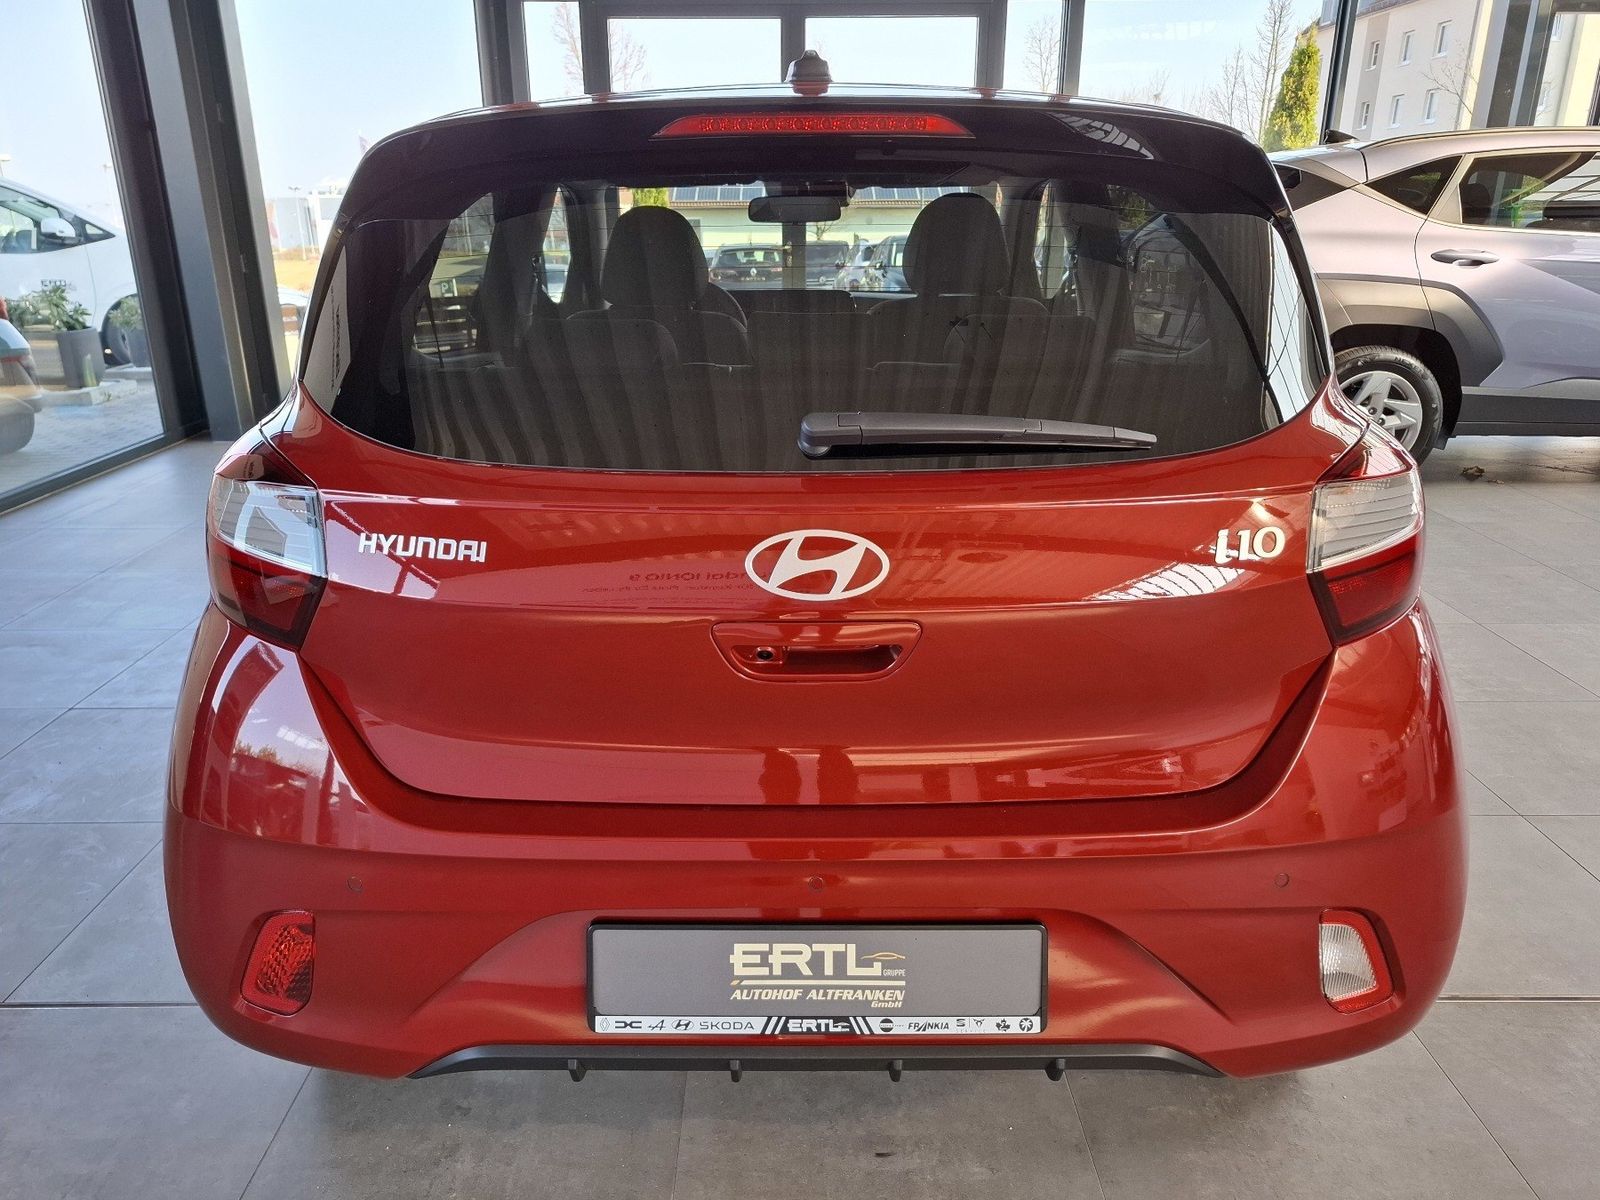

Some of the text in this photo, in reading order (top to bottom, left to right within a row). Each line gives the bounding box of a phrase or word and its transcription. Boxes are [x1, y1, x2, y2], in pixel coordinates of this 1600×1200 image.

[358, 532, 487, 563] HYUNDAI
[1214, 526, 1286, 565] i10
[729, 943, 906, 977] ERTL GRUPPE
[730, 988, 906, 1001] AUTOHOF ALTFRANKEN
[870, 1000, 903, 1008] GmbH
[787, 1018, 842, 1032] ERTL
[907, 1021, 950, 1032] FRANKIA
